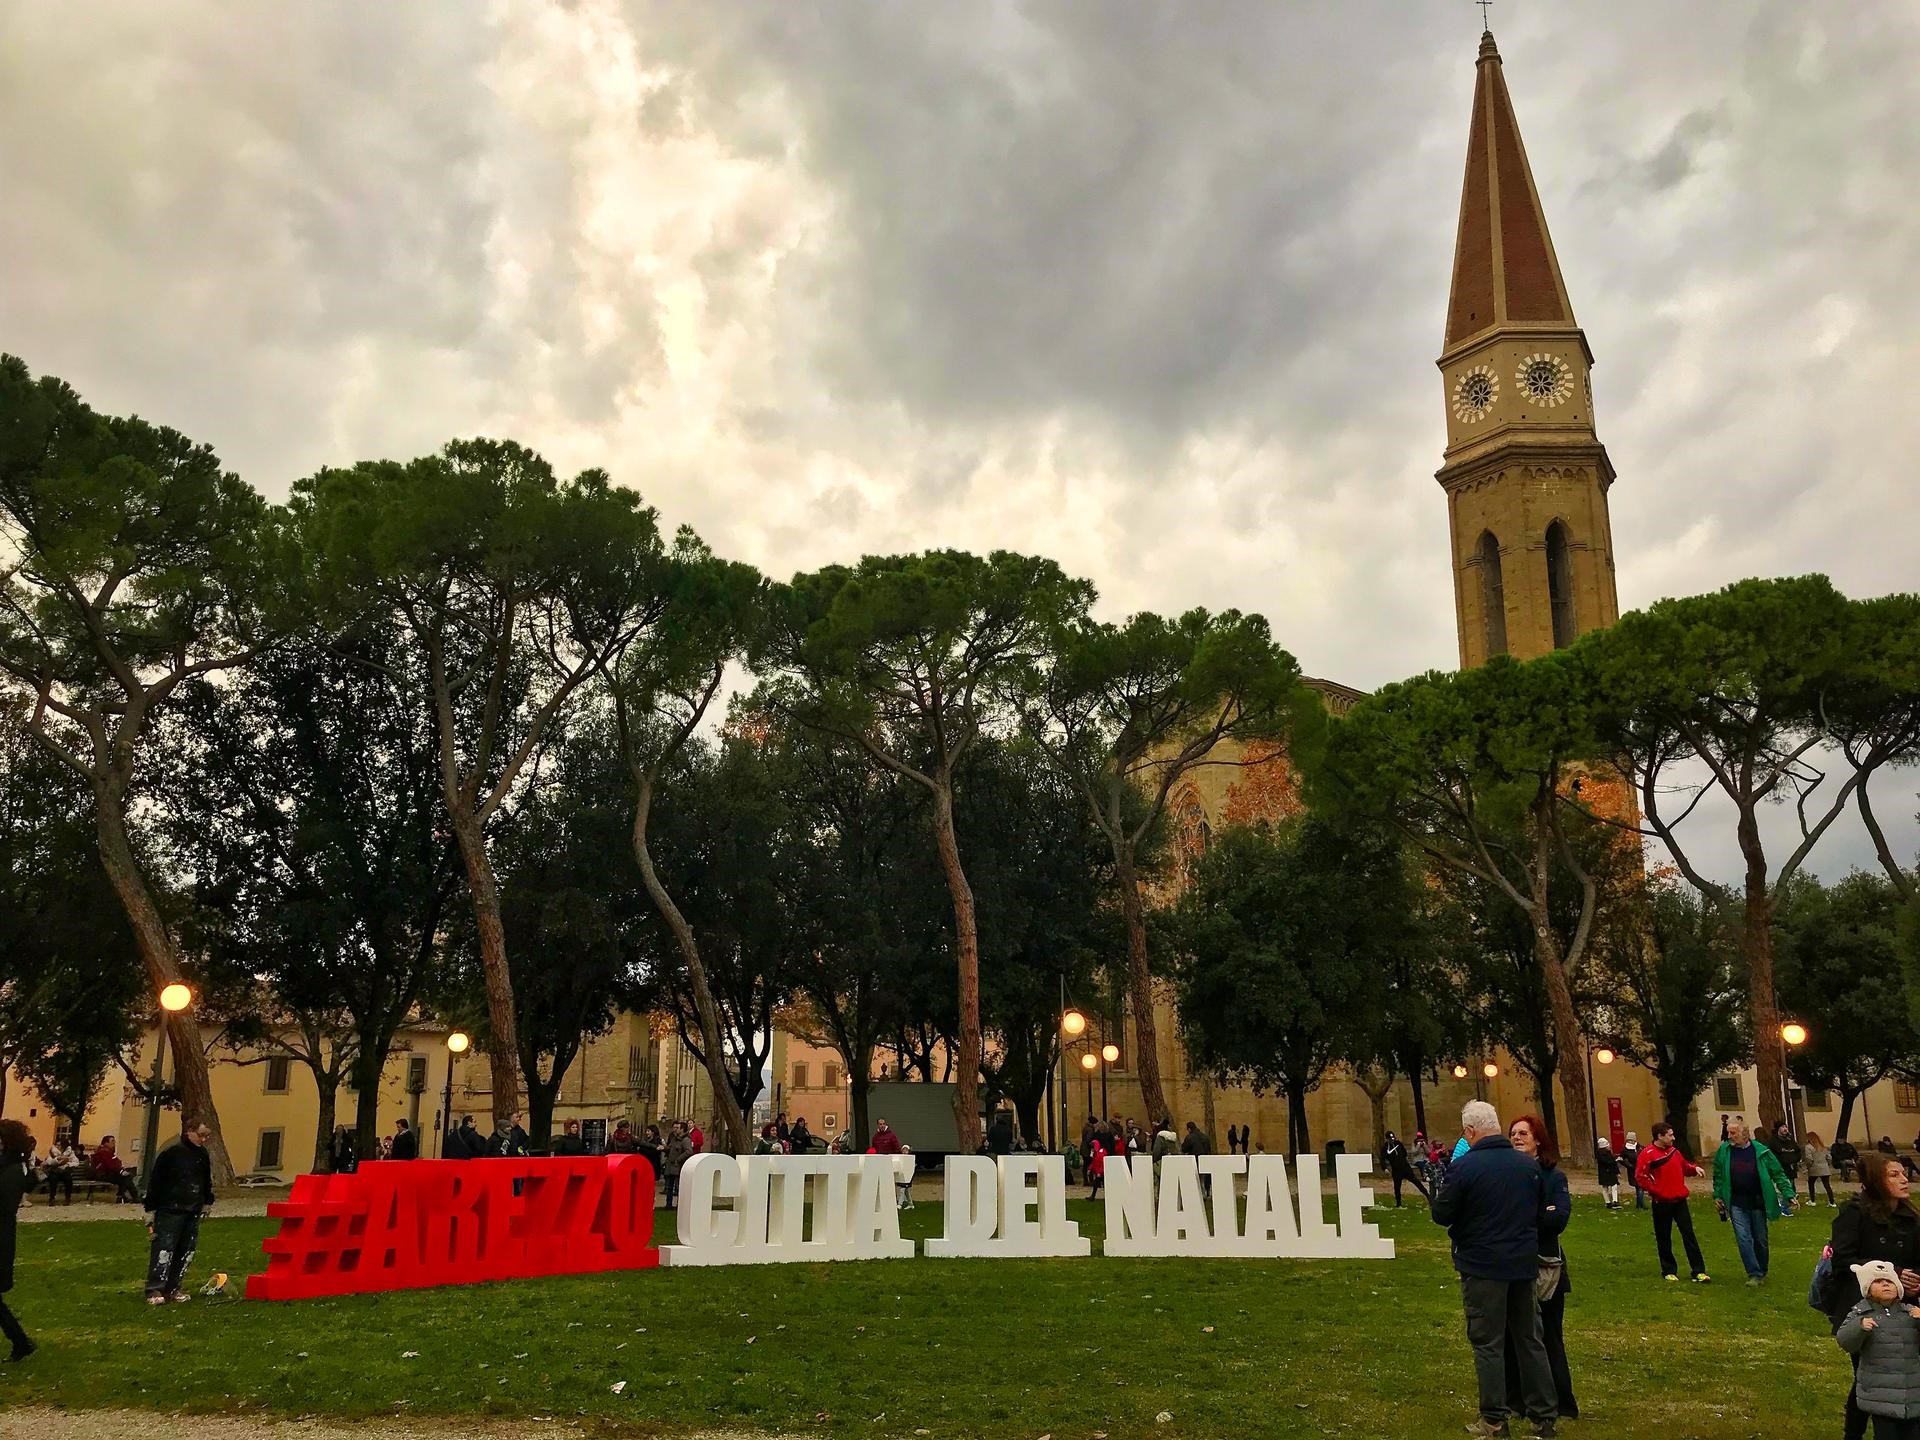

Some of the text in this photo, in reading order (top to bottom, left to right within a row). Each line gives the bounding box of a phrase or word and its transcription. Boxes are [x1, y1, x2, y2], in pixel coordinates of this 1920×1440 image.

[260, 1153, 656, 1291] #AREZZO
[942, 1154, 1080, 1243] DEL
[1103, 1154, 1383, 1243] NATALE
